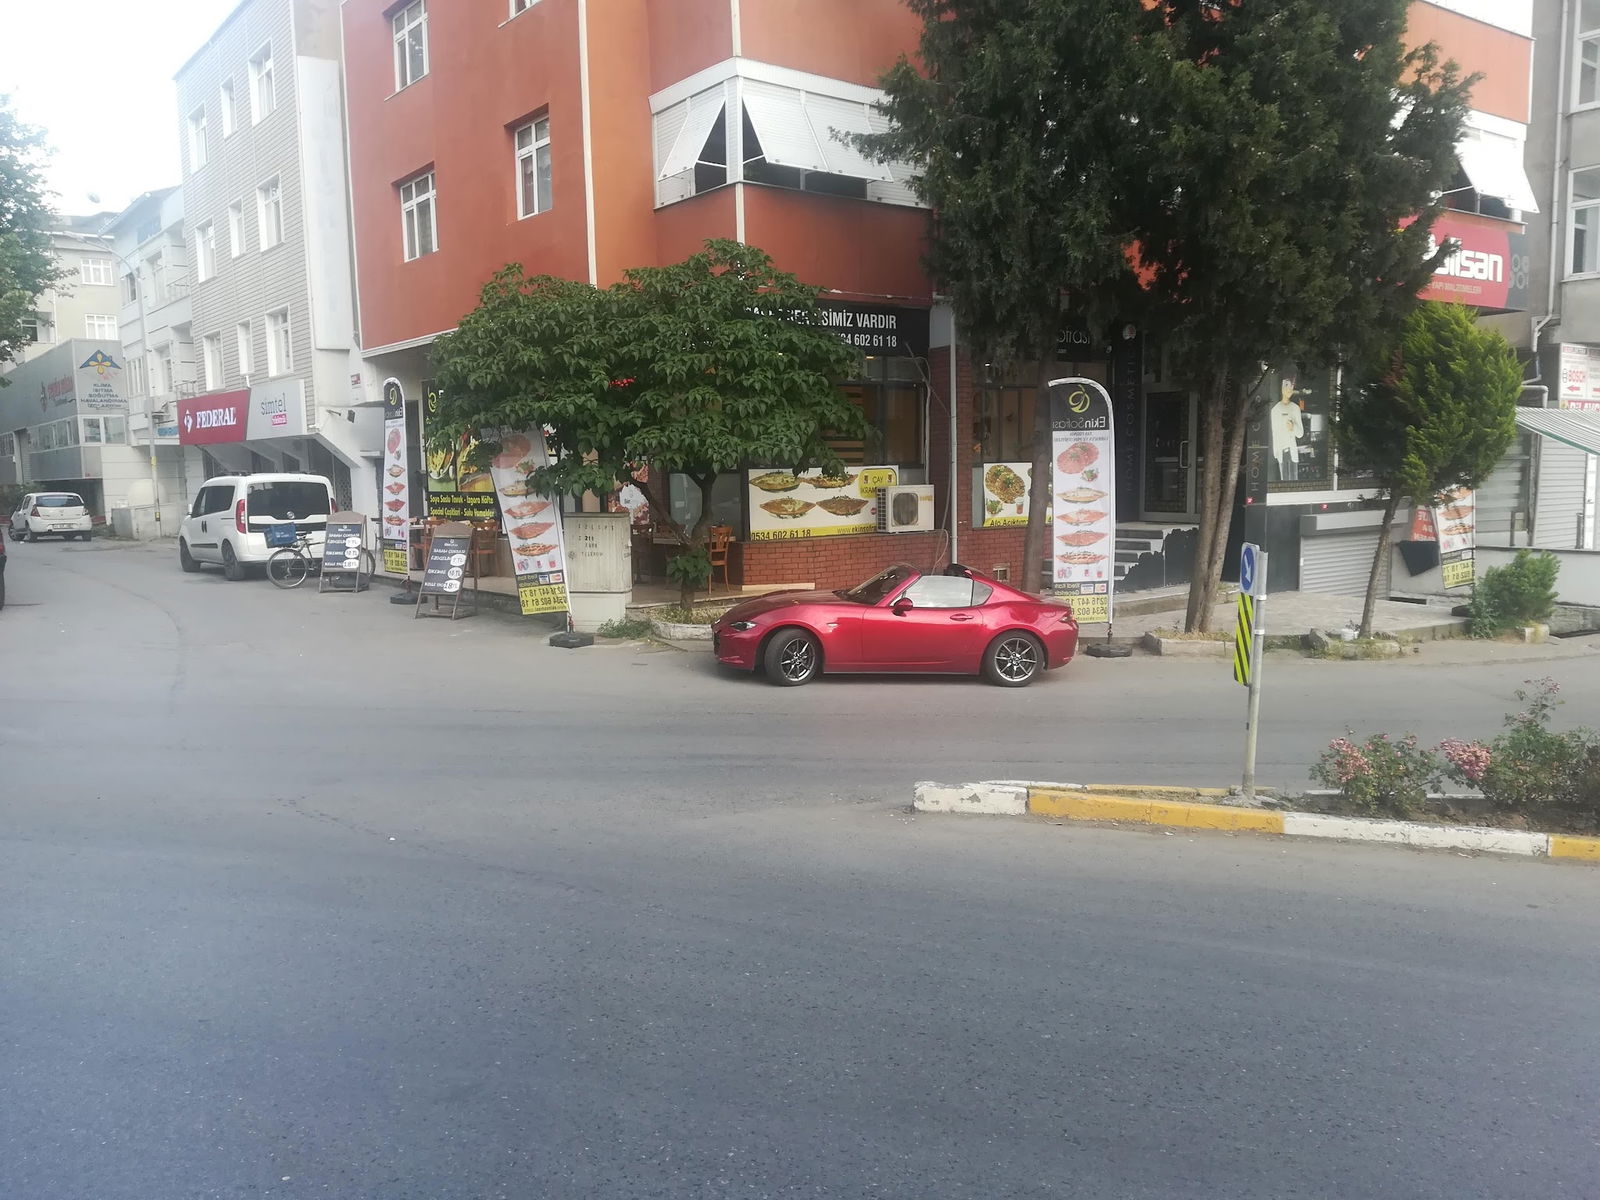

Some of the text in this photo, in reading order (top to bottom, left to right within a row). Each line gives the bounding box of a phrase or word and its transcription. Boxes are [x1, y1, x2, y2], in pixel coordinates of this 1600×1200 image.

[856, 314, 897, 330] VARDIR
[854, 333, 870, 347] 602
[872, 334, 883, 347] 61
[886, 335, 897, 348] 18
[260, 392, 287, 415] simtel
[196, 407, 237, 429] FEDERAL
[773, 530, 787, 540] 602
[789, 529, 799, 539] 61
[801, 528, 812, 538] 18
